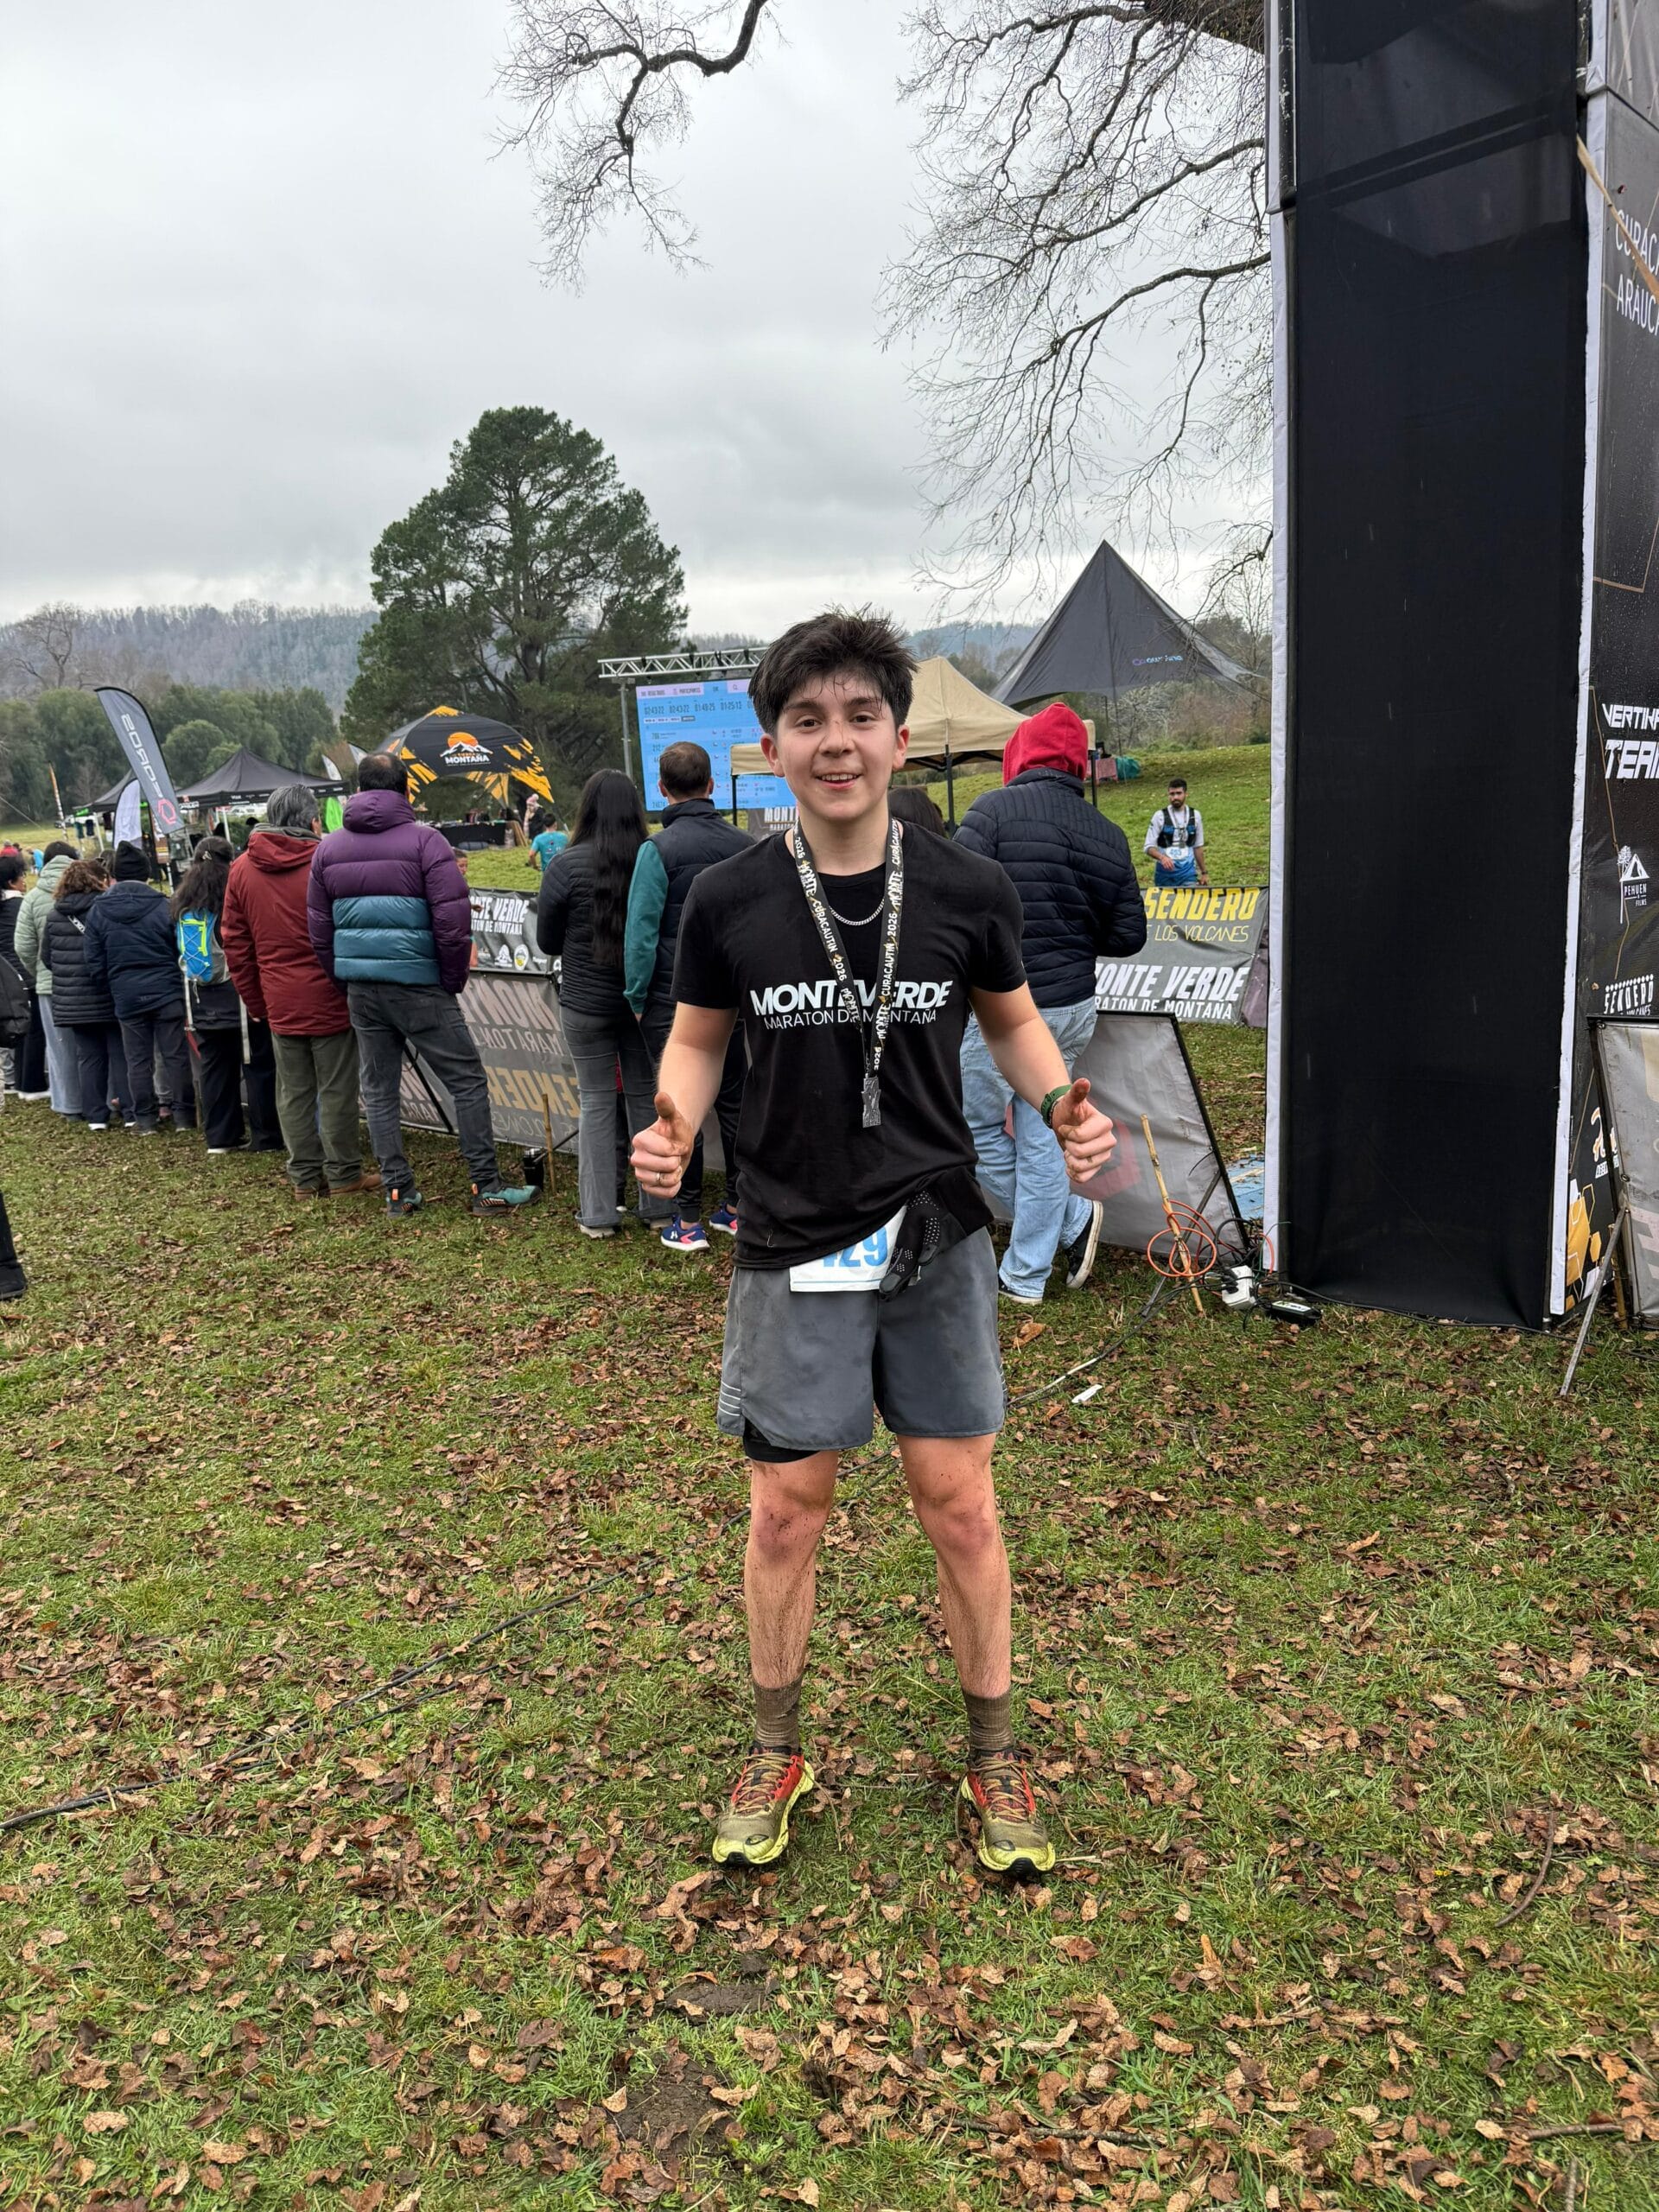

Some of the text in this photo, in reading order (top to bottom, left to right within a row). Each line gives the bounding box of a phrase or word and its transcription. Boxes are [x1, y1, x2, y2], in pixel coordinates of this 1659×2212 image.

[493, 898, 530, 923] VERDE
[1143, 887, 1261, 922] SENDERO
[887, 912, 899, 937] 2026
[1154, 925, 1179, 942] LOS
[1185, 925, 1249, 943] VOLCANES
[812, 900, 839, 953] CURACAUTIN
[832, 955, 848, 982] 2026
[880, 943, 895, 996] CURACAUTIN
[1161, 965, 1250, 1001] VERDE
[764, 1011, 835, 1030] MARATON
[863, 1007, 937, 1026] MNTAÑA
[1164, 998, 1233, 1020] MONTAÑA
